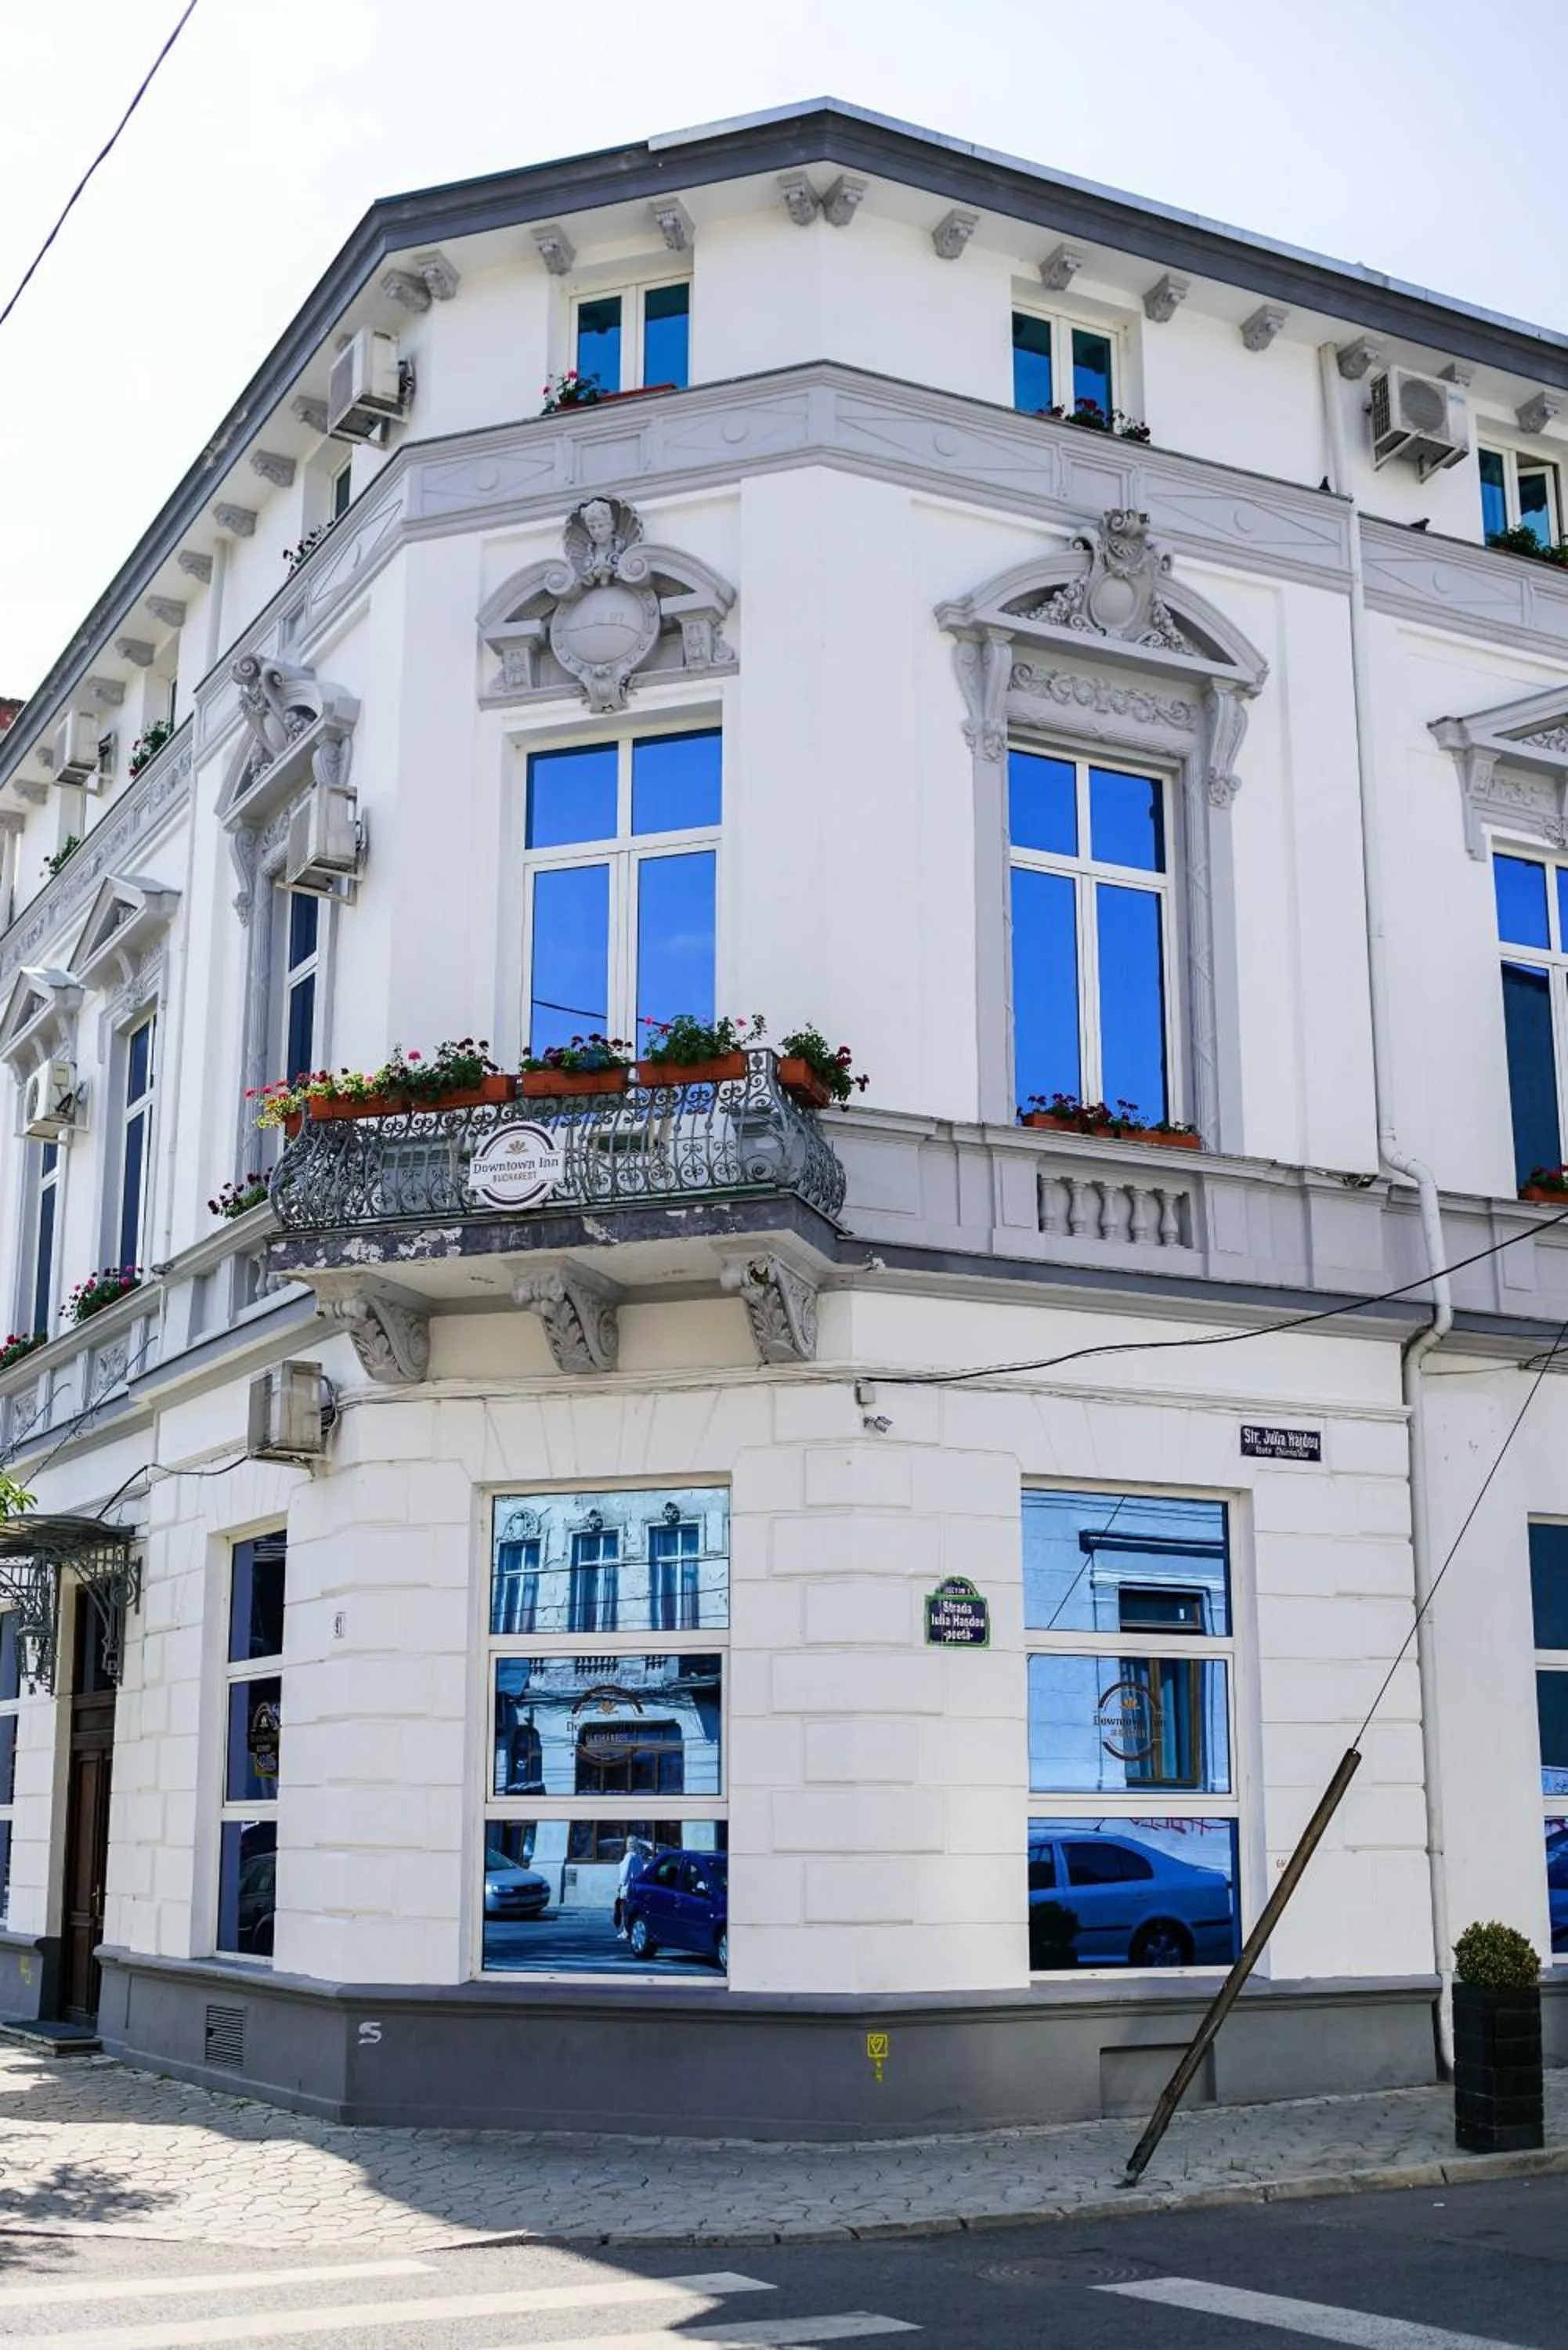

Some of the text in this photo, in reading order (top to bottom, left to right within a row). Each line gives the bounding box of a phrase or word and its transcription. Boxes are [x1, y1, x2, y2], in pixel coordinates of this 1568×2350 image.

[473, 1157, 558, 1173] Downtown Inn
[942, 1600, 972, 1614] Strada
